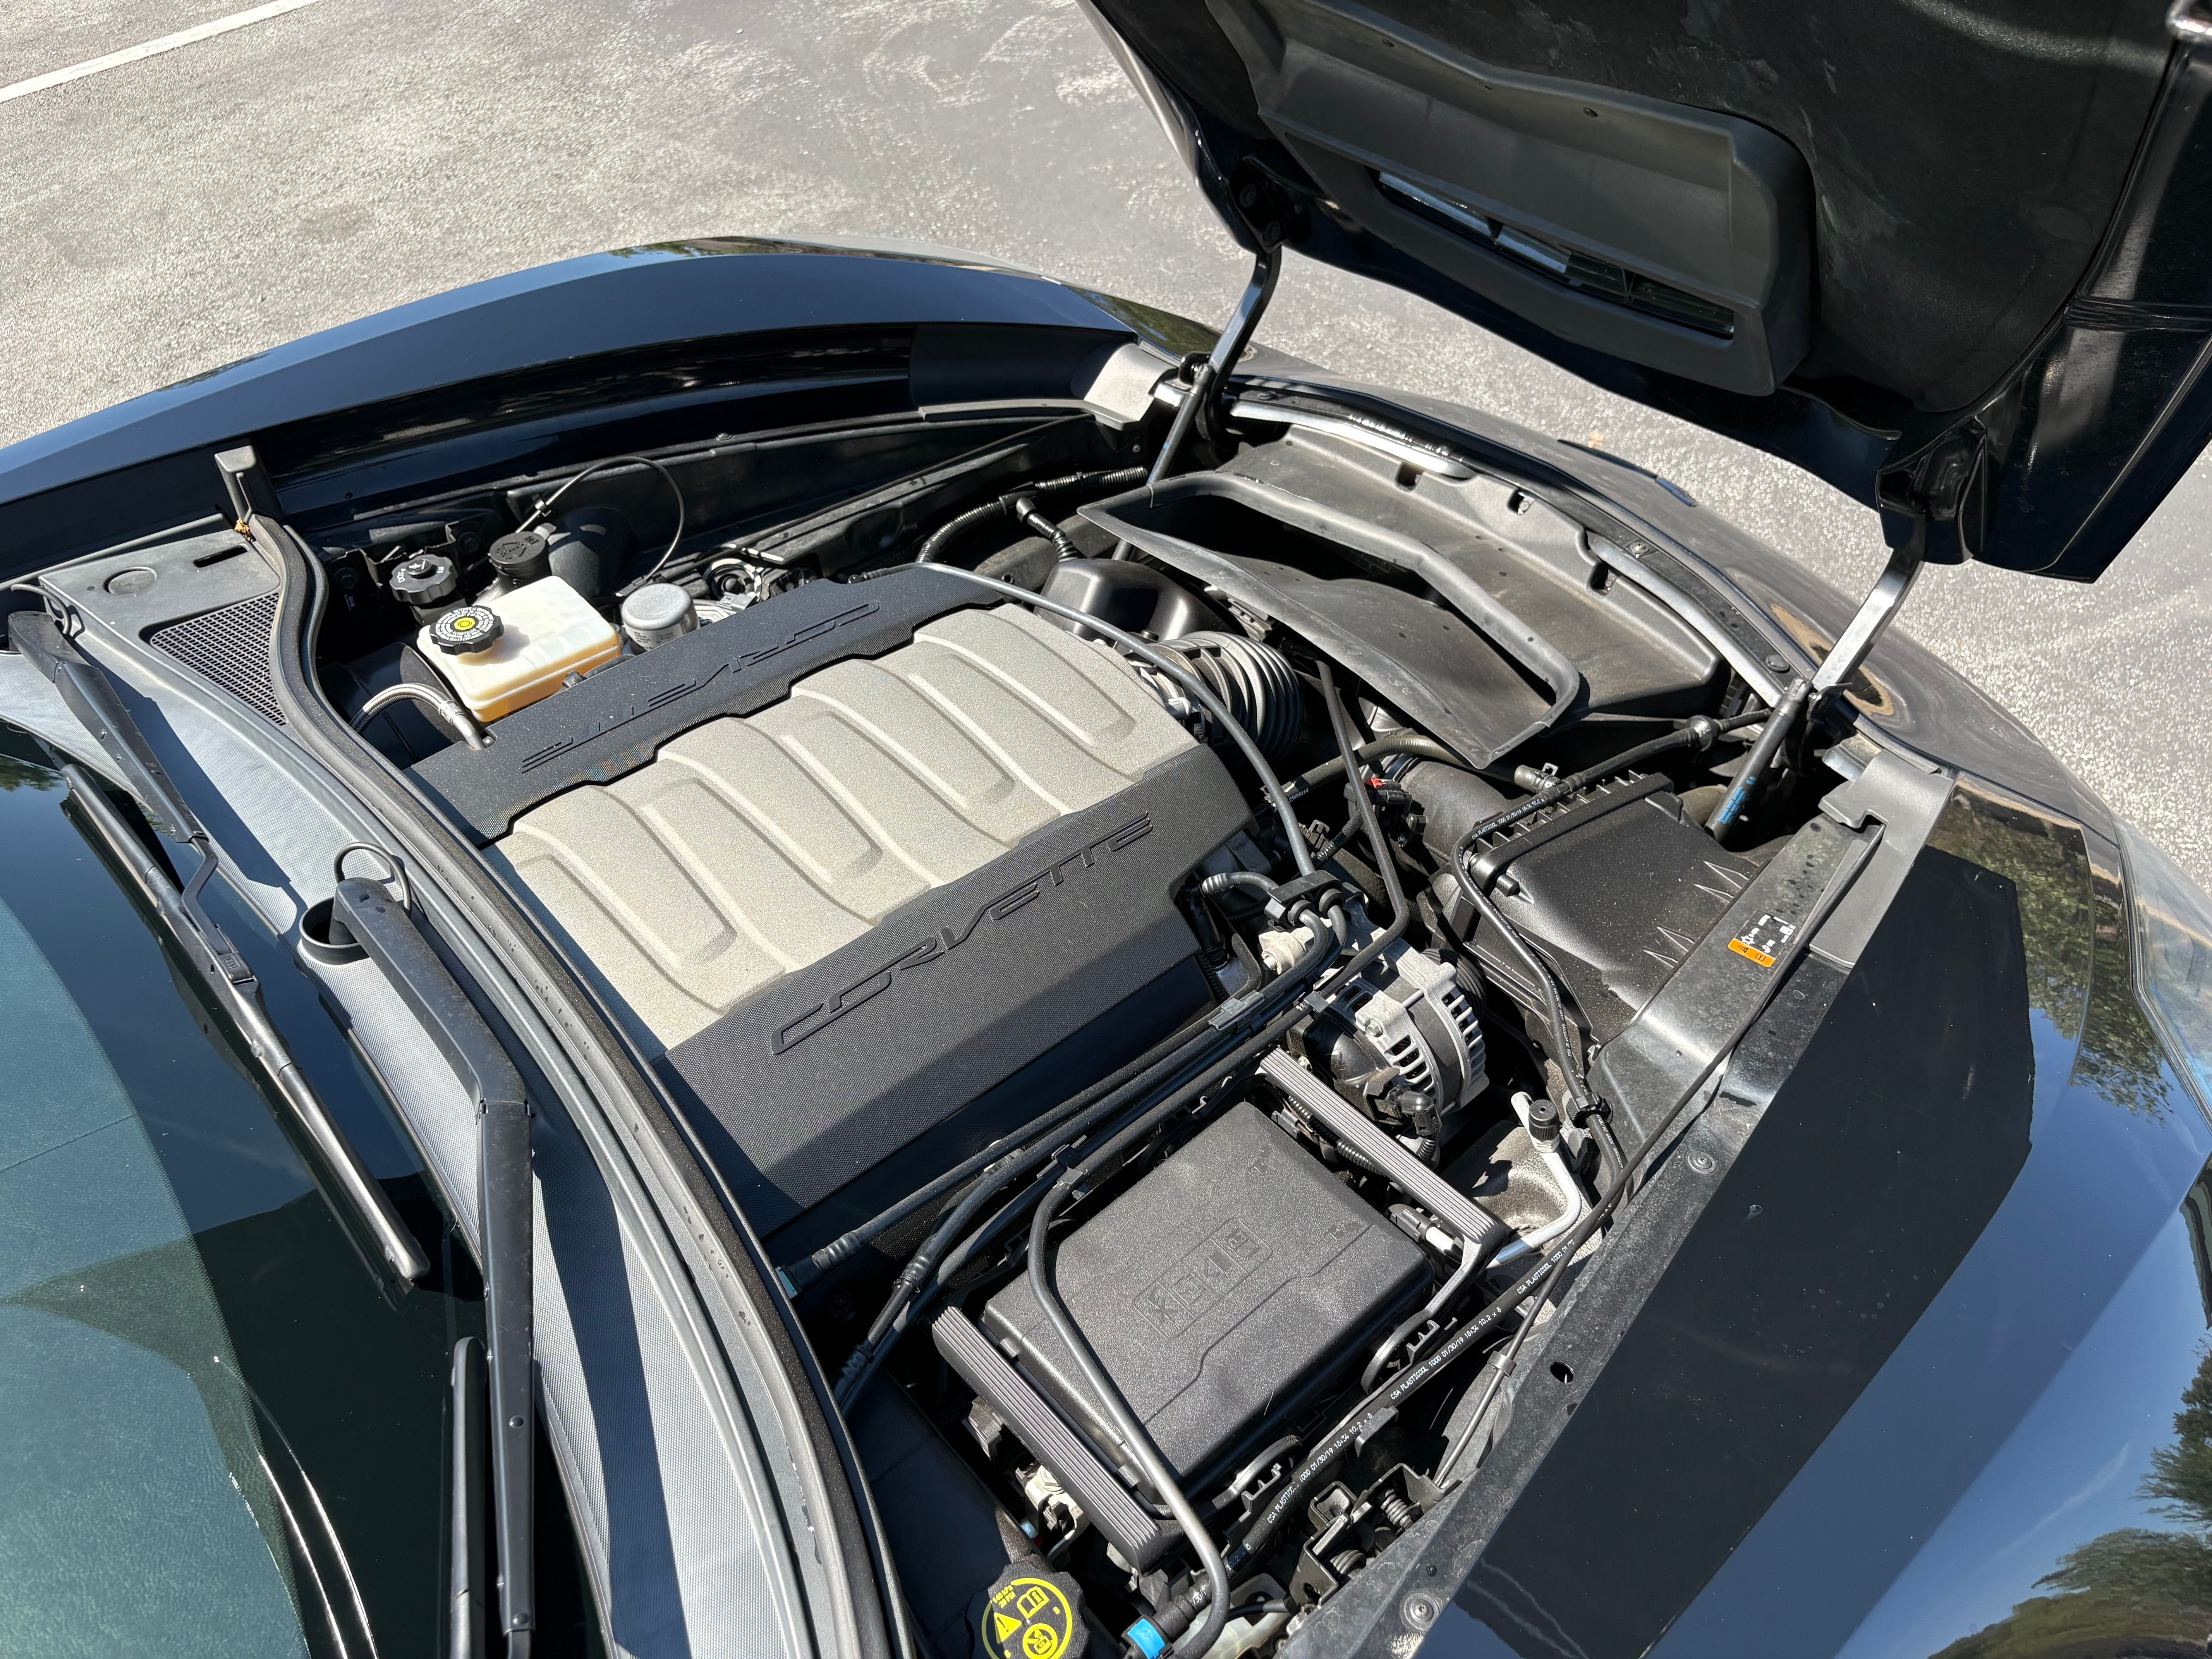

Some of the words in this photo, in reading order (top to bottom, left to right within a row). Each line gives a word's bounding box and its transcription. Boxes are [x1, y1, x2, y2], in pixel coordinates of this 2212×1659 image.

[771, 811, 1154, 1054] CORVETTE
[1517, 1284, 1527, 1294] CSA
[1526, 1262, 1552, 1286] PLASTICOOL
[1551, 1251, 1563, 1263] 1000
[1390, 1389, 1401, 1400] CSA
[1400, 1366, 1429, 1391] PLASTICOOL
[1429, 1355, 1441, 1367] 1000
[1441, 1337, 1464, 1357] 01/30/19
[1464, 1324, 1479, 1339] 18:34
[1479, 1314, 1492, 1329] 10.2
[1267, 1511, 1278, 1523] CSA
[1310, 1447, 1333, 1471] 01/30/19
[1334, 1433, 1350, 1449] 18:34
[1349, 1421, 1363, 1435] 10.2
[993, 1592, 1003, 1604] 140
[999, 1599, 1007, 1609] 20
[1005, 1590, 1016, 1602] PSI
